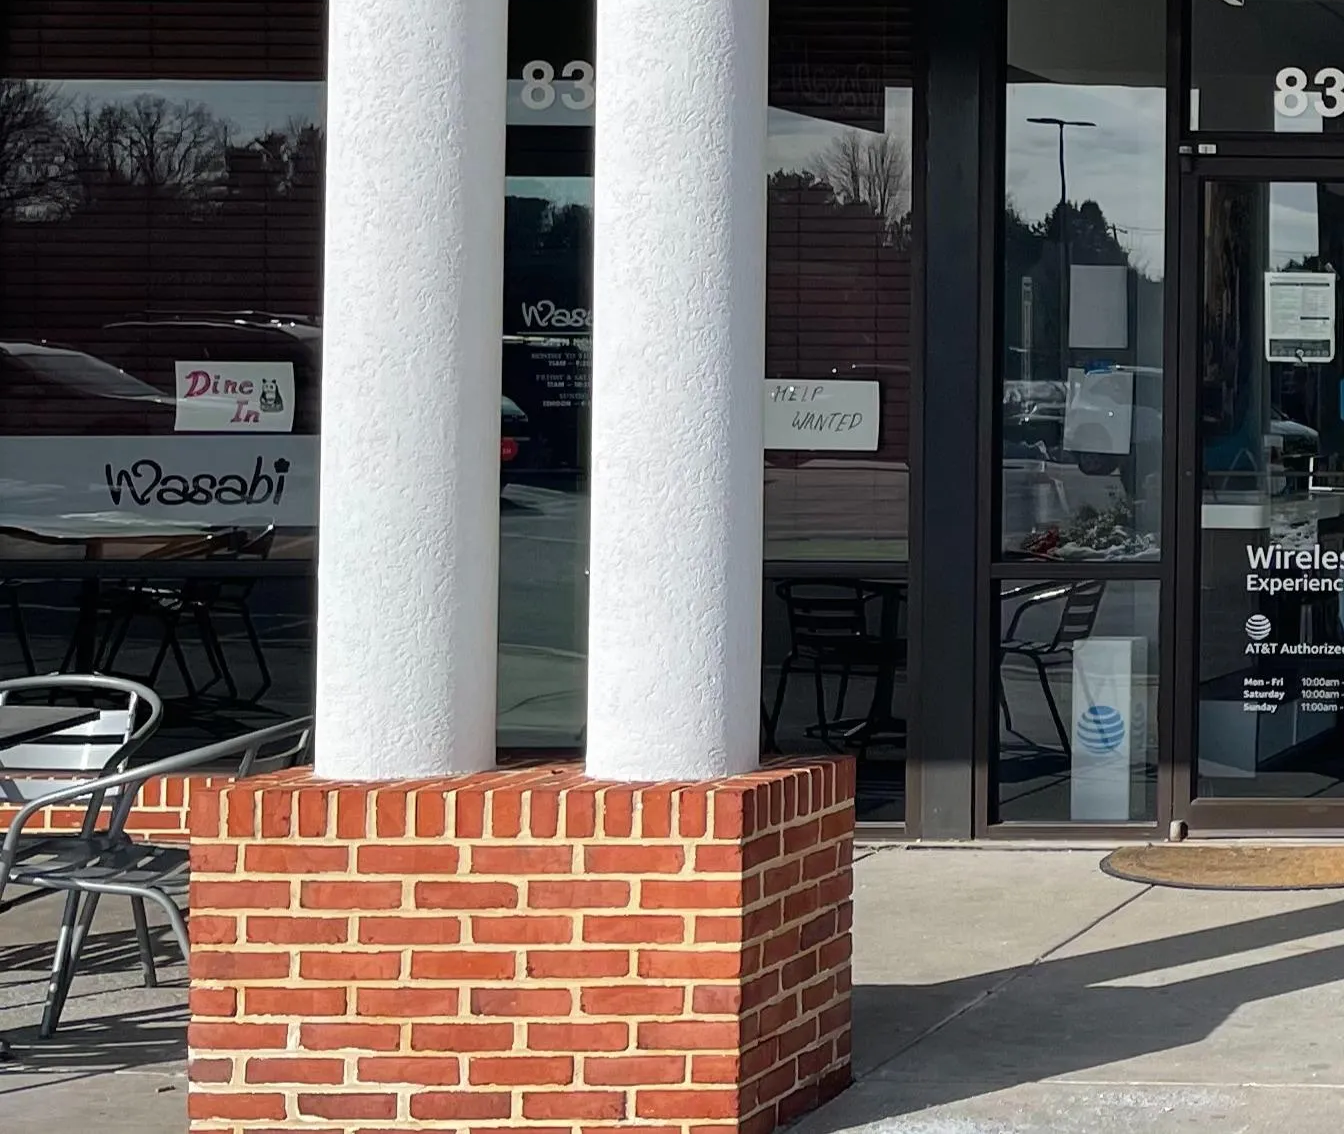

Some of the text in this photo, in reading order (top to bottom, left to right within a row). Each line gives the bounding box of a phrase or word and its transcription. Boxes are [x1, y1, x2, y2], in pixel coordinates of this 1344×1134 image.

[521, 59, 594, 110] 83
[184, 370, 254, 398] Dine
[774, 385, 824, 402] HELP
[230, 400, 260, 423] In
[791, 411, 864, 432] WANTED
[105, 456, 290, 506] Wasabi
[1245, 643, 1278, 655] AT&T
[1243, 677, 1264, 687] Mon
[1272, 677, 1284, 686] Fri
[1243, 690, 1286, 701] Saturday
[1243, 703, 1278, 714] Sunday
